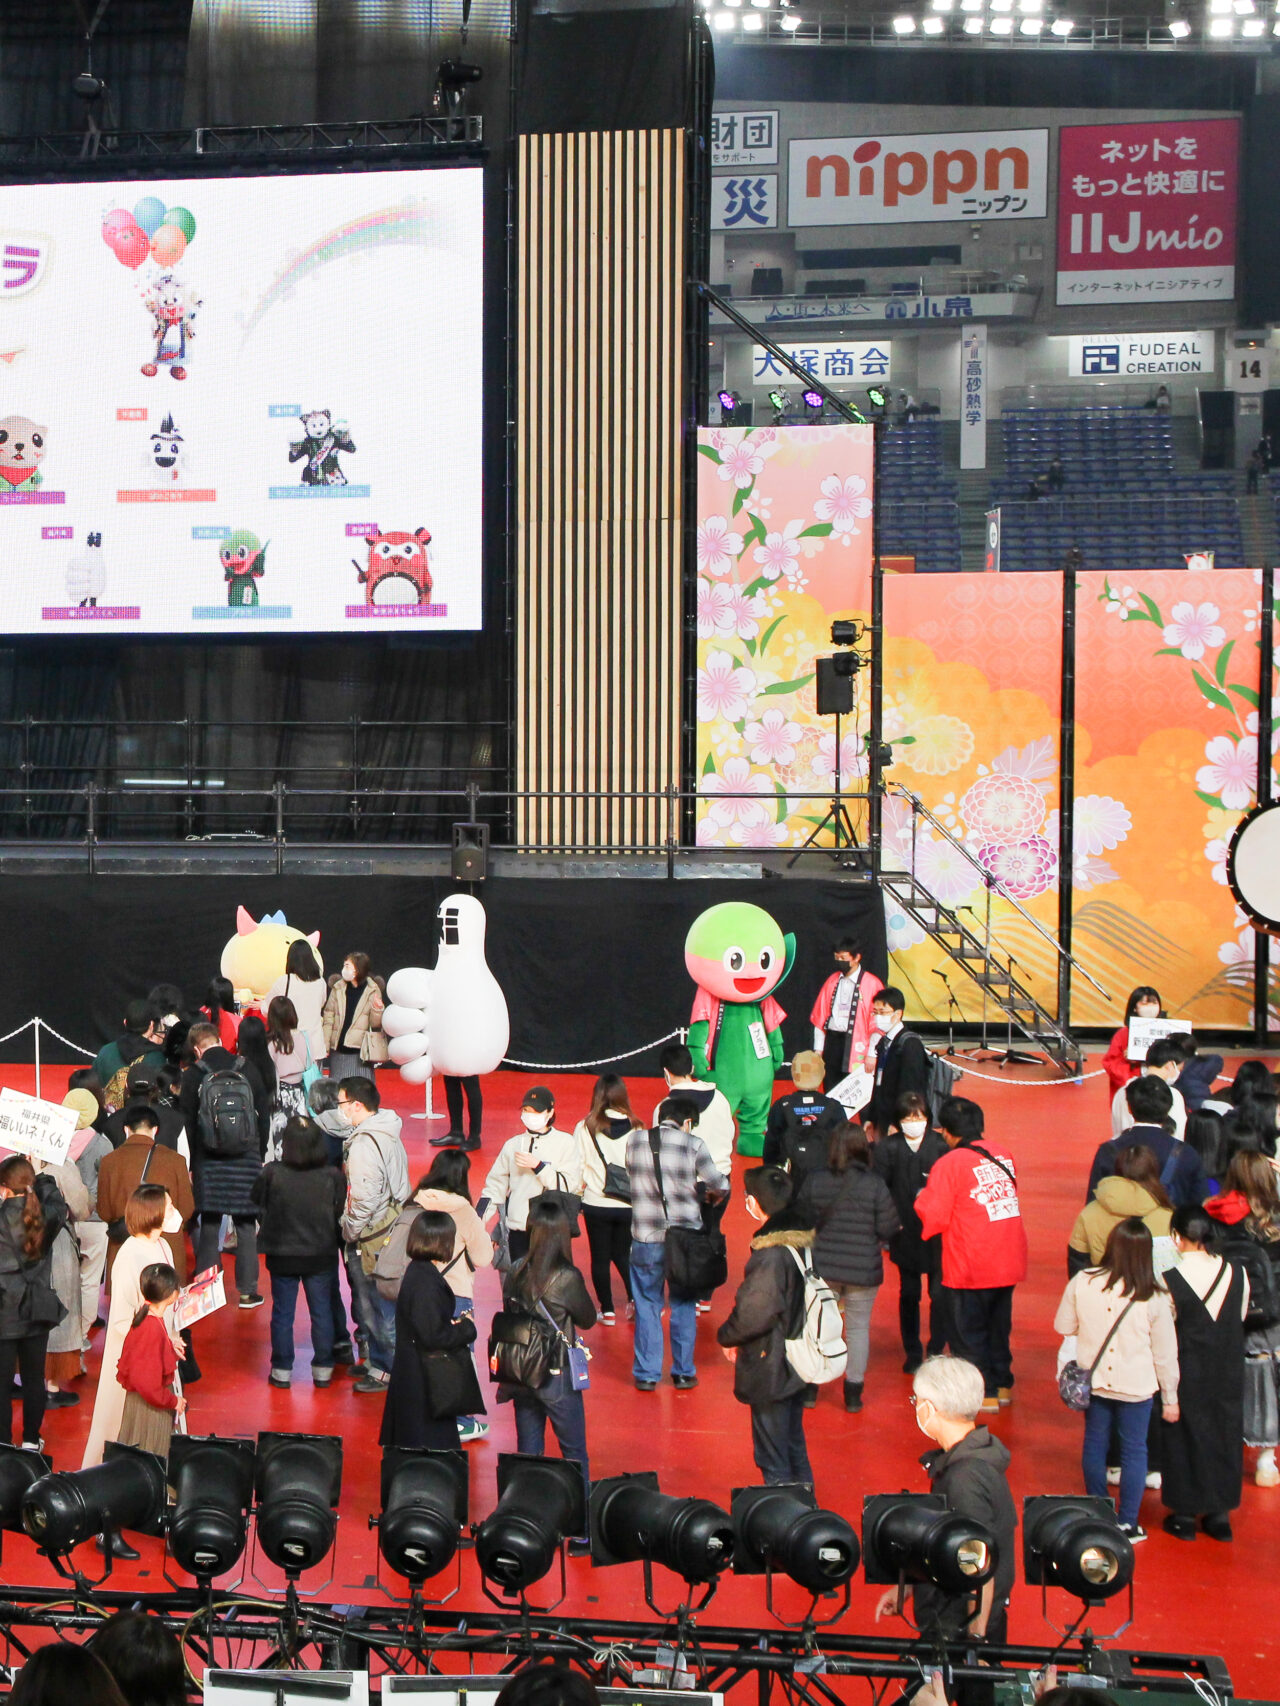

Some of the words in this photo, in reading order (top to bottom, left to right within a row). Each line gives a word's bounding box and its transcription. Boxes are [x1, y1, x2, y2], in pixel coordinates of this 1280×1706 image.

[1100, 137, 1198, 163] ネットを
[806, 141, 1029, 207] nippn
[1072, 170, 1225, 197] もっと快適に
[723, 178, 769, 227] 災
[962, 195, 1028, 215] ニップン
[1071, 211, 1224, 254] IIJmio
[754, 347, 890, 377] 大塚商会
[1129, 342, 1201, 357] FUDEAL
[1126, 360, 1202, 374] CREATION
[1240, 360, 1262, 378] 14
[965, 360, 982, 426] 高砂熱学
[21, 1109, 51, 1125] 福井県
